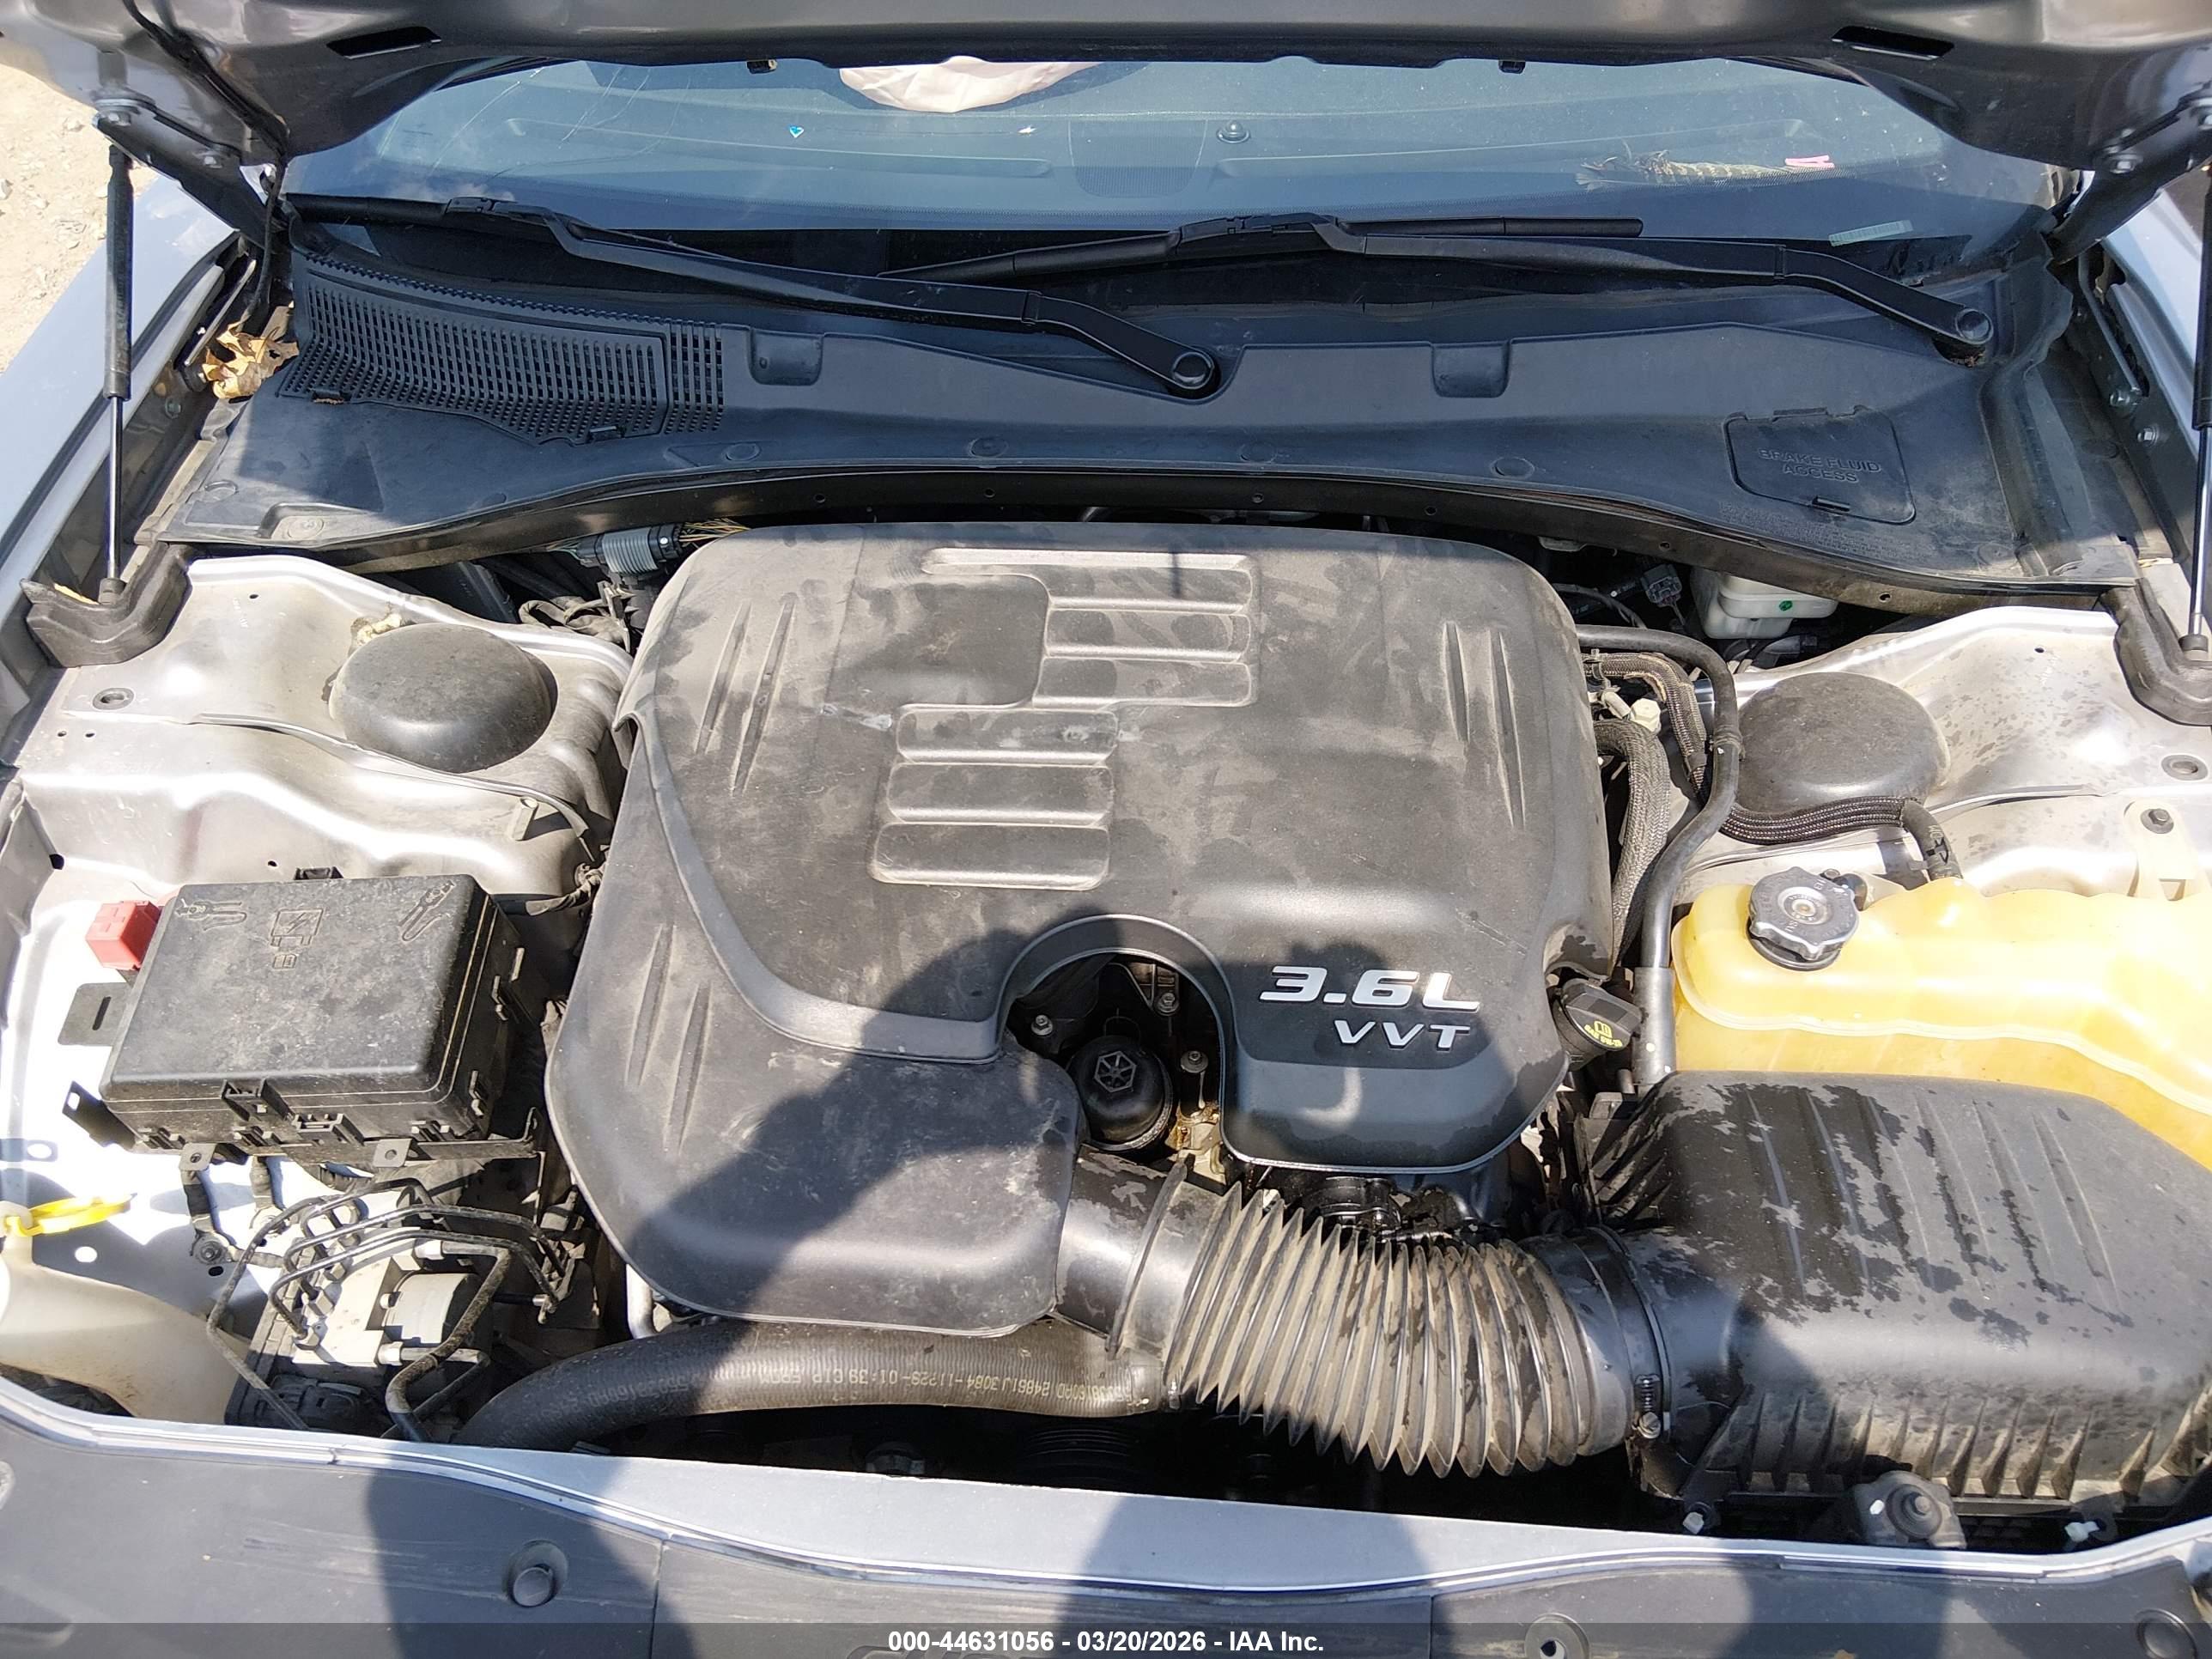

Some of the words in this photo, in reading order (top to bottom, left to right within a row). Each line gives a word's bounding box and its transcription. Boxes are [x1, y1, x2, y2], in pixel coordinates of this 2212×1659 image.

[1759, 449, 1822, 465] BRAKE
[1826, 457, 1882, 472] FLUID
[1783, 465, 1859, 483] ACCESS
[1259, 965, 1480, 1011] 3.6L
[1334, 1019, 1471, 1049] VVT
